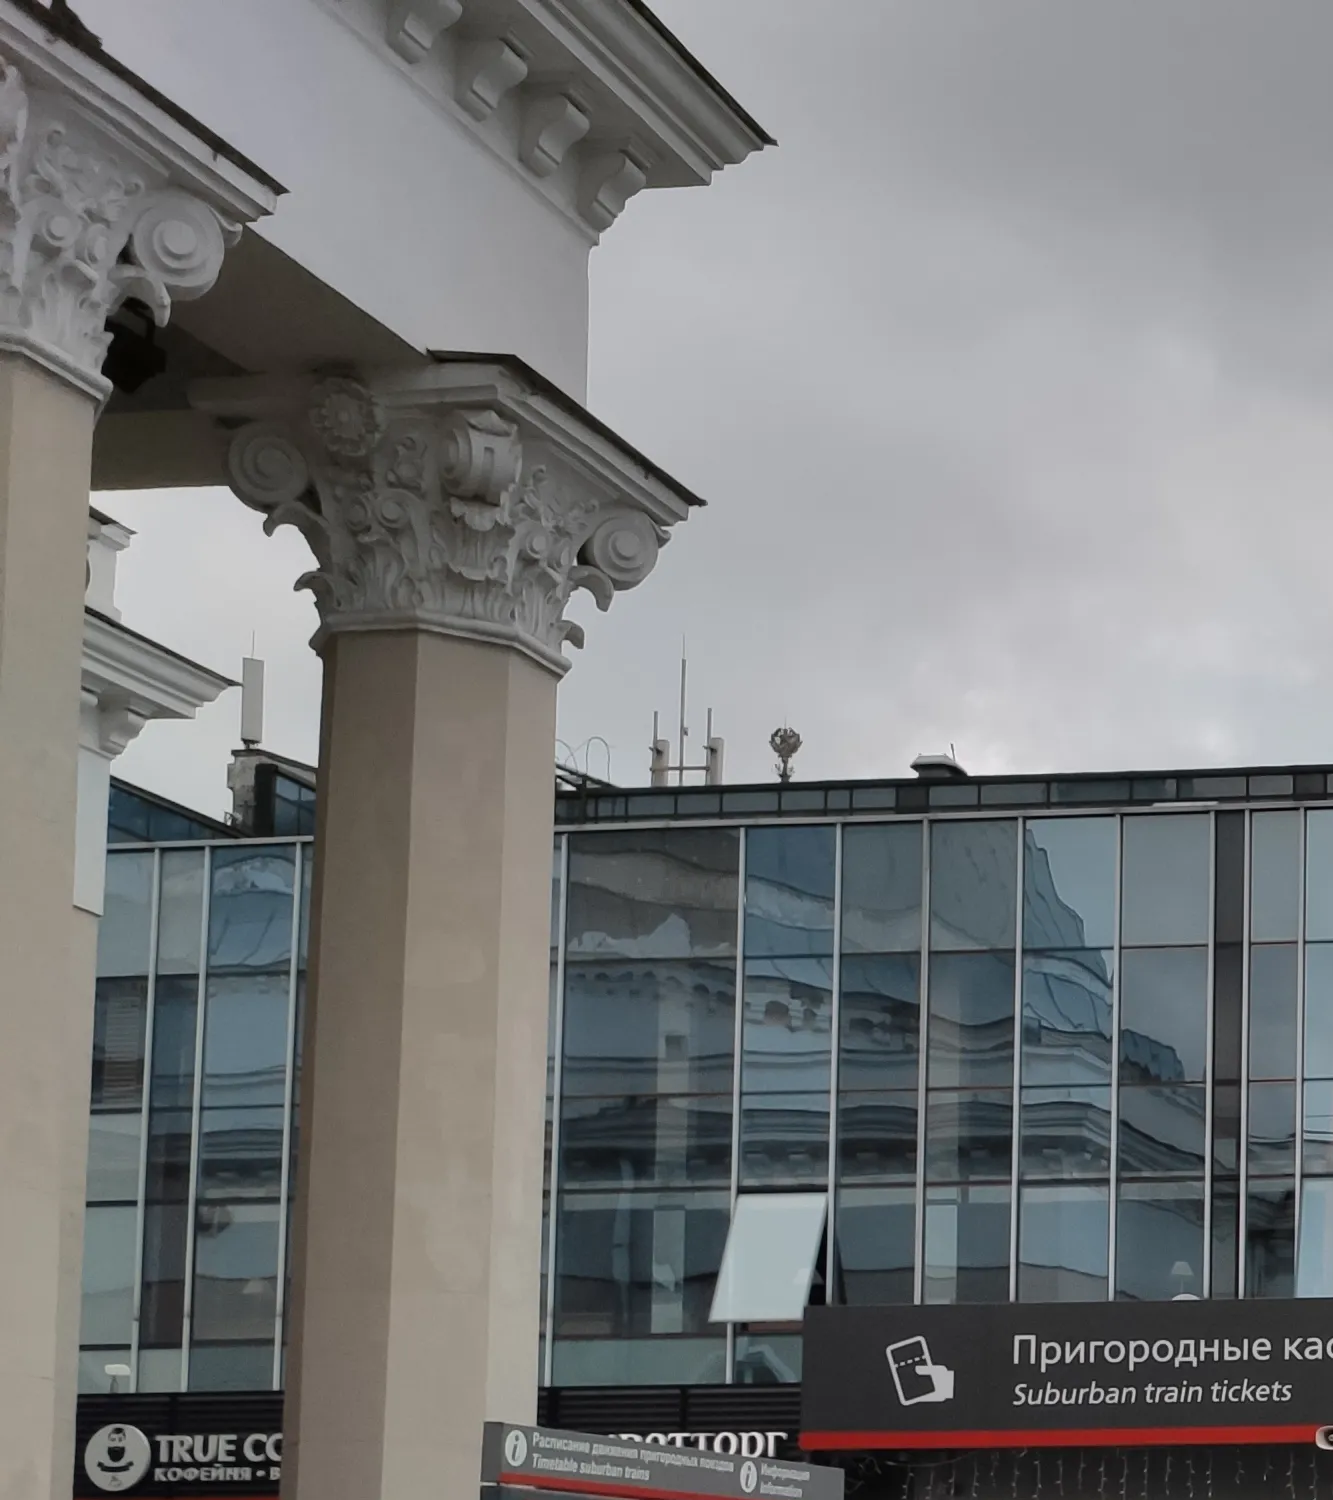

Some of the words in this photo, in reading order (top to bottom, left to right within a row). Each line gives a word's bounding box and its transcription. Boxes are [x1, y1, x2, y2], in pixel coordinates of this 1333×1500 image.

[1013, 1334, 1272, 1372] Пригородные
[1012, 1381, 1136, 1406] Suburban
[1144, 1381, 1203, 1404] train
[1210, 1378, 1293, 1403] tickets
[155, 1434, 238, 1463] TRUE
[154, 1463, 252, 1482] КОФЕЙНЯ
[532, 1453, 578, 1473] Timetable
[579, 1460, 623, 1477] suburban
[624, 1466, 650, 1481] trains
